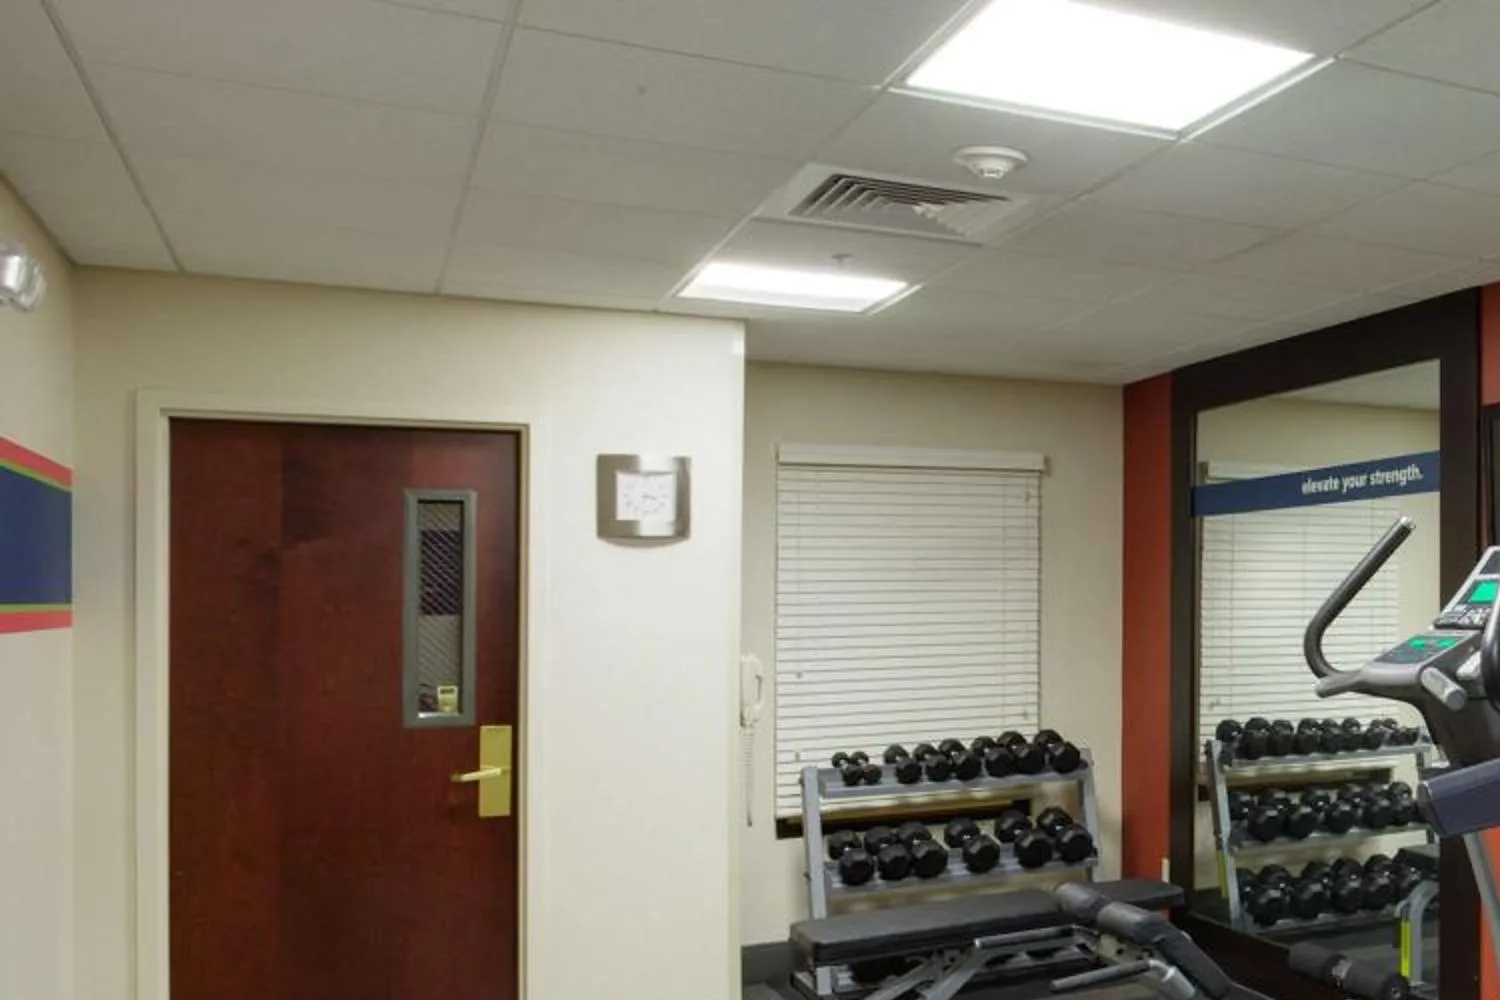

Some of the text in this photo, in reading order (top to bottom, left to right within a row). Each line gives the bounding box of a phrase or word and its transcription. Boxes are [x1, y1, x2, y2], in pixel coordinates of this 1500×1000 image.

[1301, 463, 1424, 495] elevate your strength.
